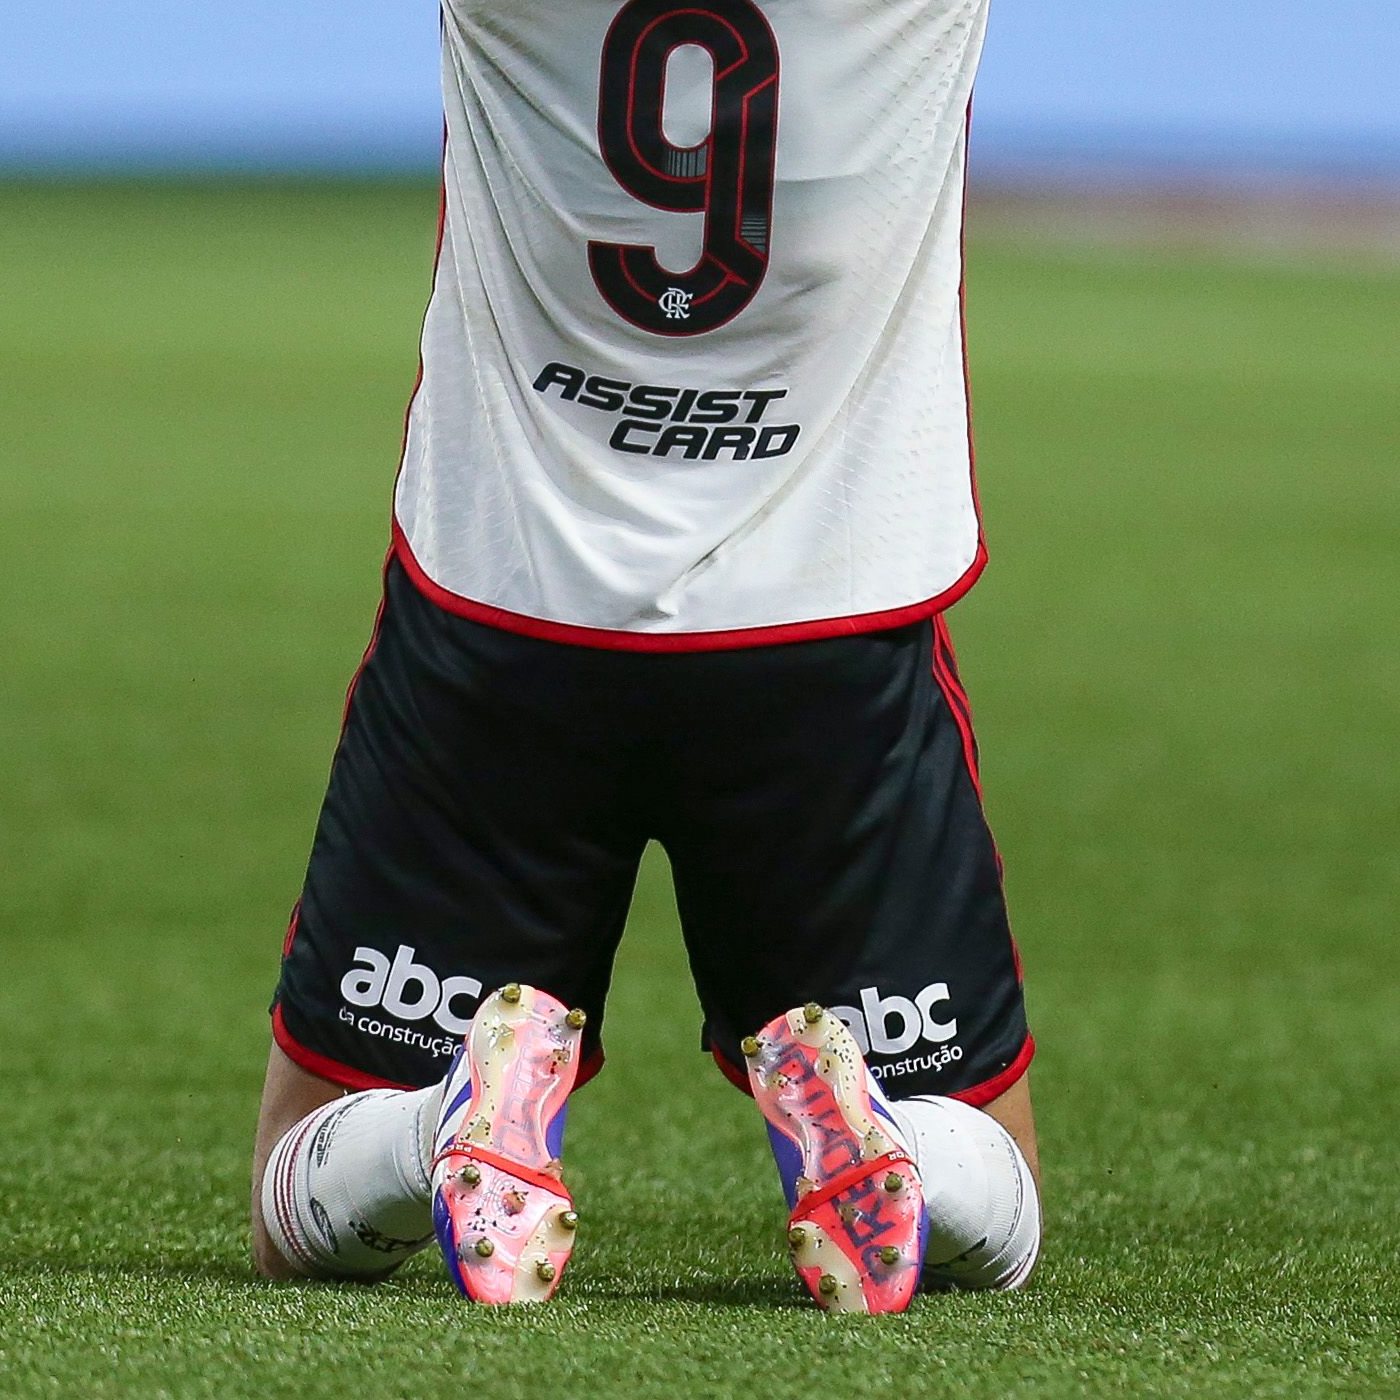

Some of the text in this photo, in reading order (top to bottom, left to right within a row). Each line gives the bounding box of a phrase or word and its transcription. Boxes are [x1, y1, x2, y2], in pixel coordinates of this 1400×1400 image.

[532, 361, 790, 425] ASSIST
[608, 418, 802, 462] CARD
[340, 944, 483, 1035] abc
[870, 1044, 964, 1080] onstrução
